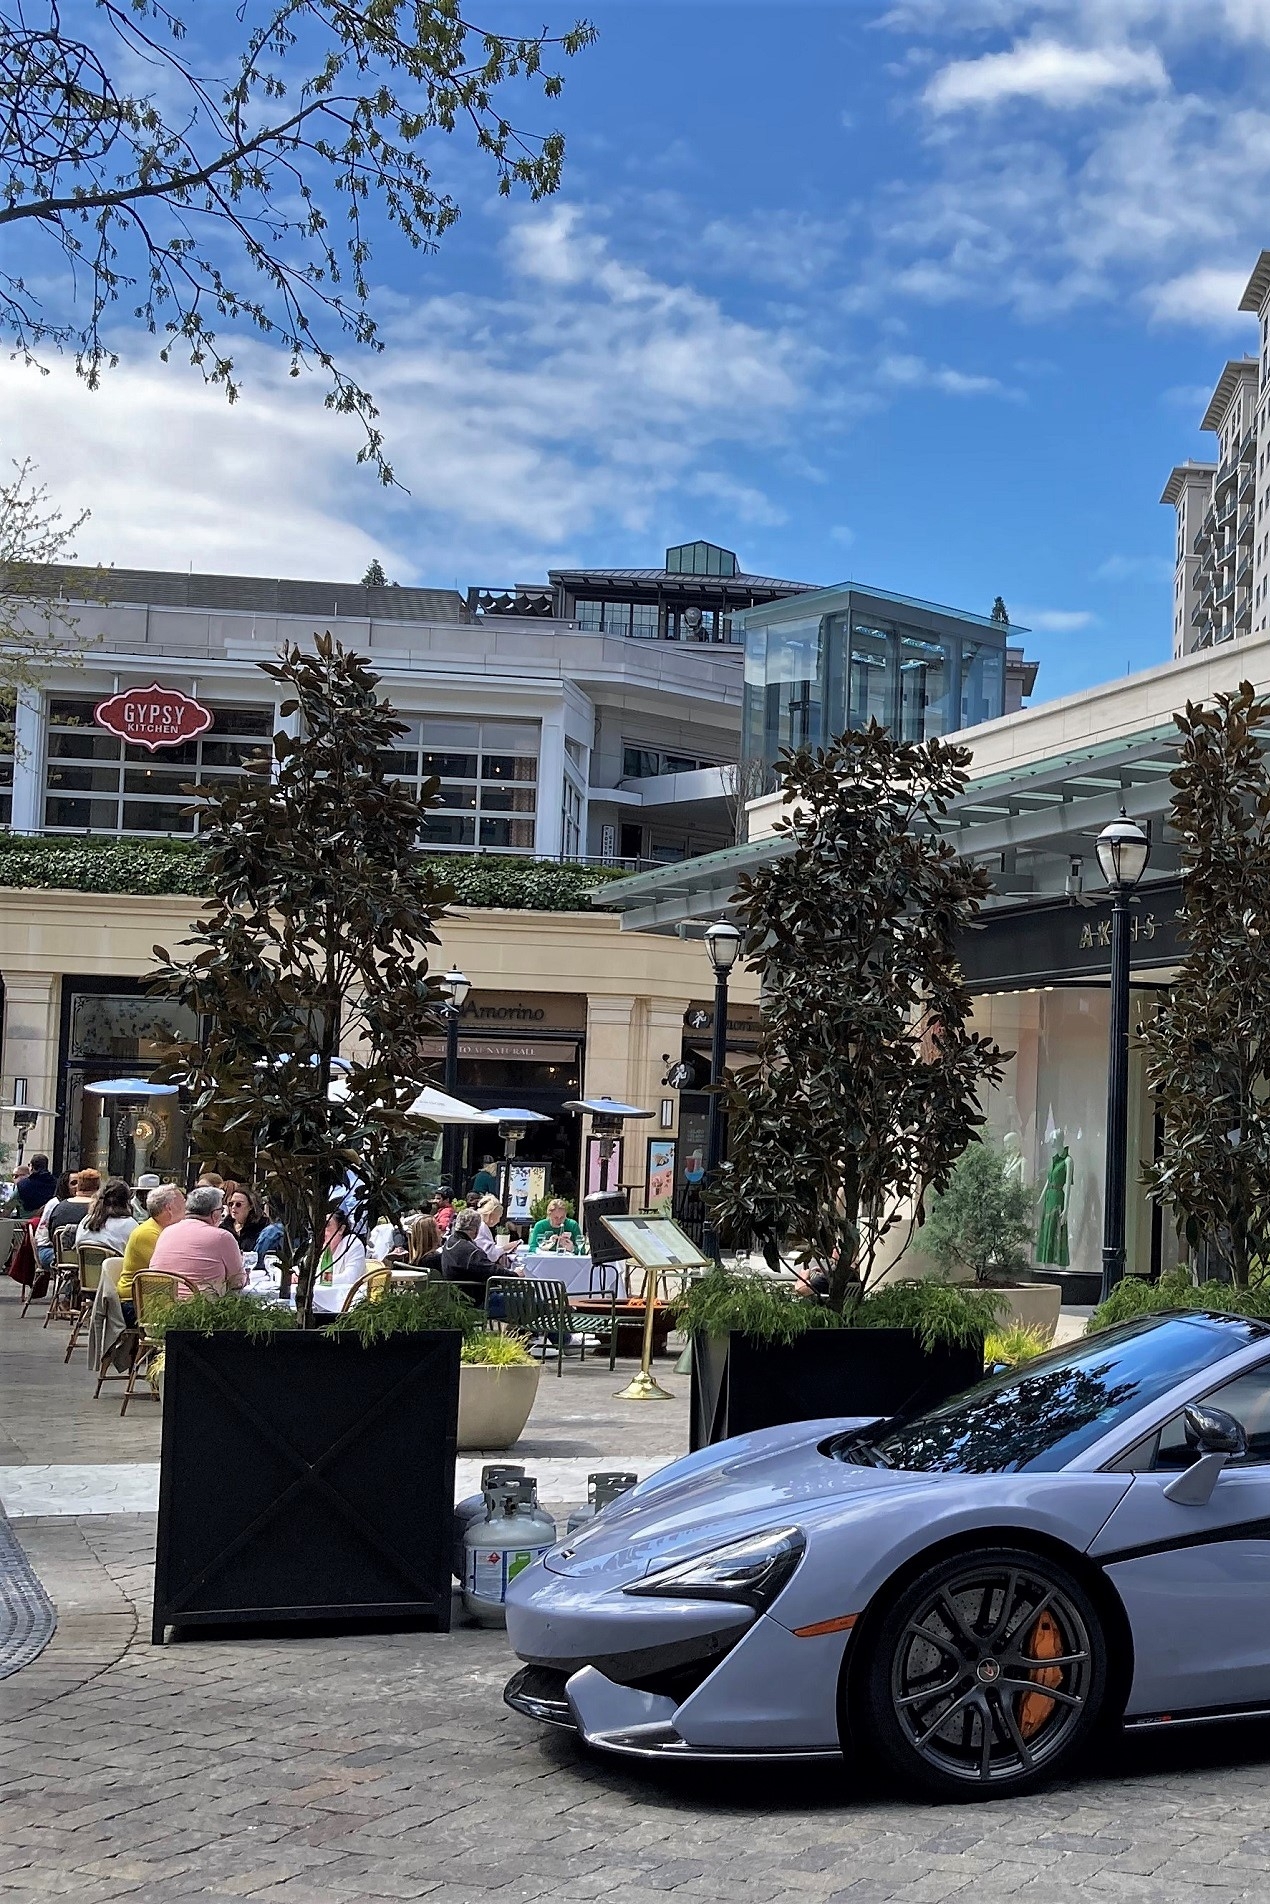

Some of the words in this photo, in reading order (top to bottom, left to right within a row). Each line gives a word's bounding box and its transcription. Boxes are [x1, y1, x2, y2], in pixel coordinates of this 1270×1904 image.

[124, 703, 185, 725] GYPSY
[127, 723, 179, 734] KITCHEN
[1078, 912, 1156, 949] AKIS
[462, 1000, 545, 1022] Amorino
